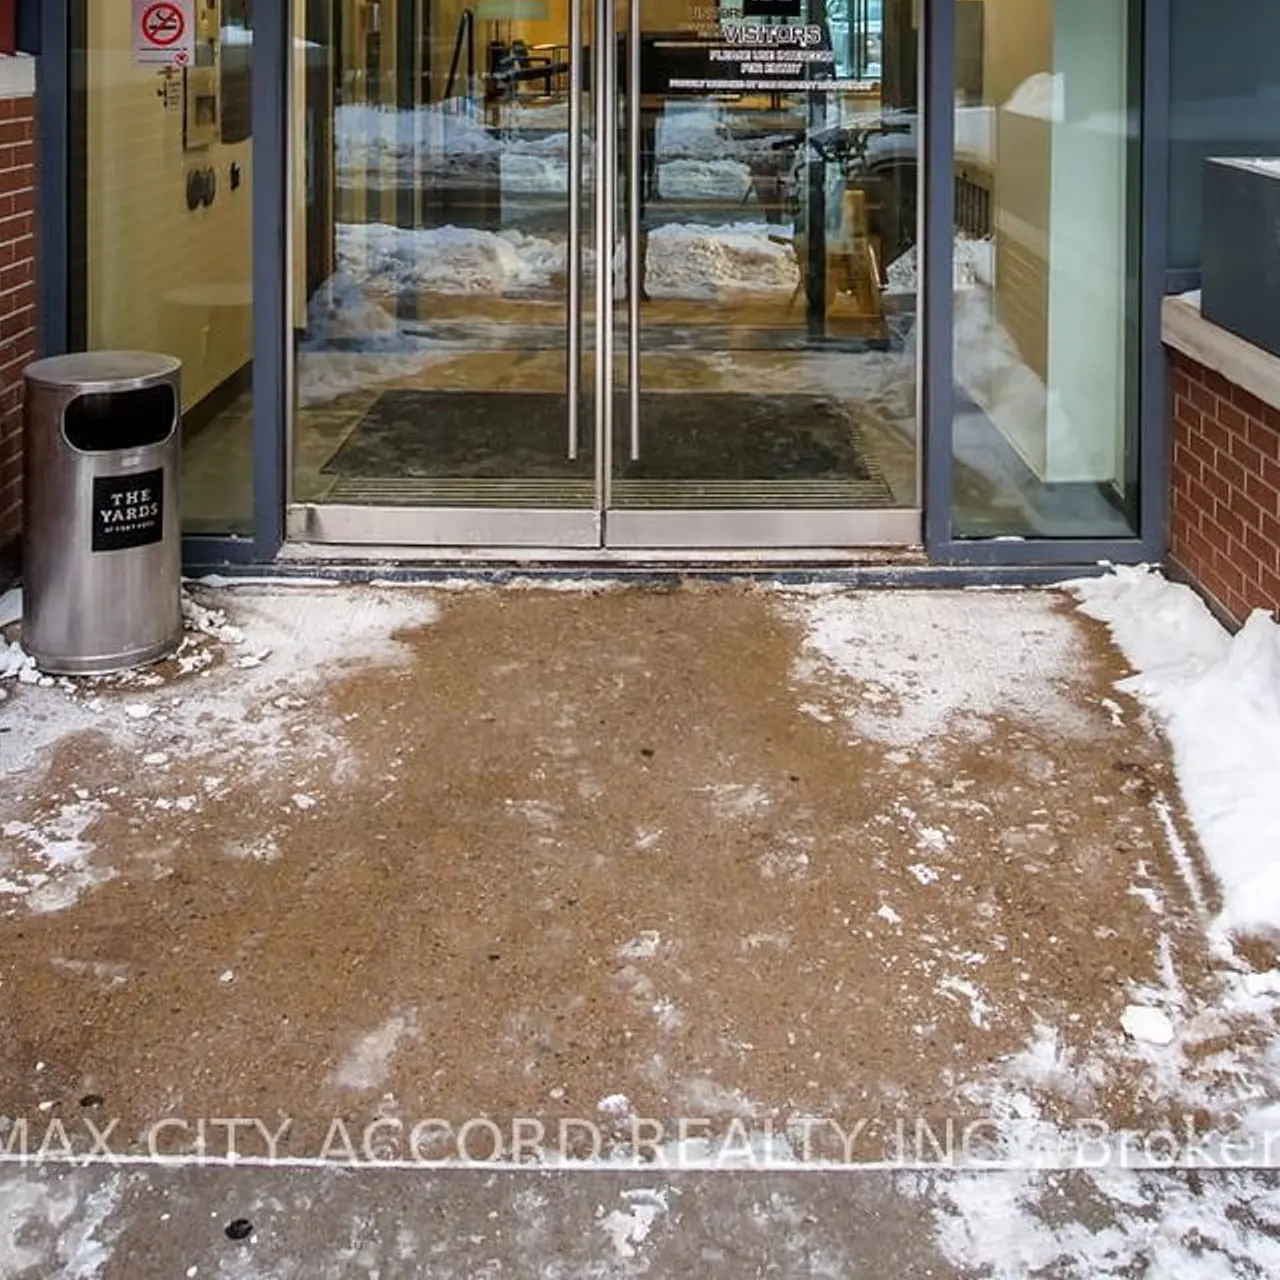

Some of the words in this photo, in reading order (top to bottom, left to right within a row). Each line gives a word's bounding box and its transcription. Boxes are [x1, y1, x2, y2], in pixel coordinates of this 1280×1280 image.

[722, 24, 821, 44] VISITORS
[111, 488, 152, 506] THE
[100, 502, 158, 523] YARDS
